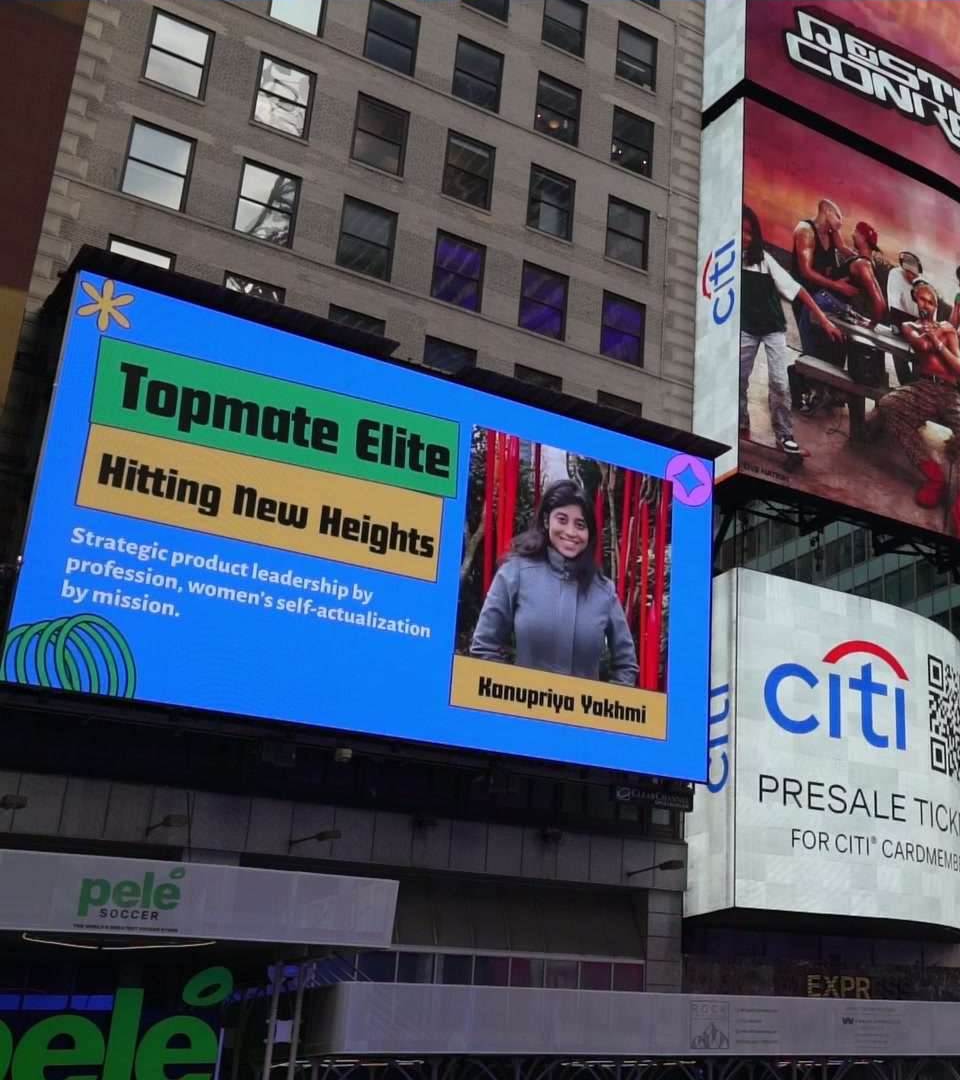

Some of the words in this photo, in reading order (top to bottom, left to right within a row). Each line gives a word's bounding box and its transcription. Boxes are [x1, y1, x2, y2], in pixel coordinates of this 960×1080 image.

[702, 239, 736, 325] citi
[119, 361, 339, 455] Topmate
[356, 420, 452, 479] Elite
[98, 453, 222, 516] Hitting
[232, 485, 309, 531] New
[319, 506, 436, 560] Heights
[60, 579, 85, 606] by
[87, 586, 180, 619] mission.
[65, 552, 184, 594] profession,
[187, 577, 273, 609] women's
[276, 595, 432, 640] self-actualization
[70, 526, 168, 565] Strategic
[171, 546, 249, 587] product
[252, 562, 350, 602] leadership
[351, 583, 374, 606] by
[478, 676, 575, 717] Kanupriya
[581, 694, 647, 726] Yakhmi
[763, 639, 910, 752] citi
[759, 773, 907, 824] PRESALE
[792, 828, 830, 852] FOR
[77, 866, 187, 918] pelé
[99, 907, 159, 921] SOCCER
